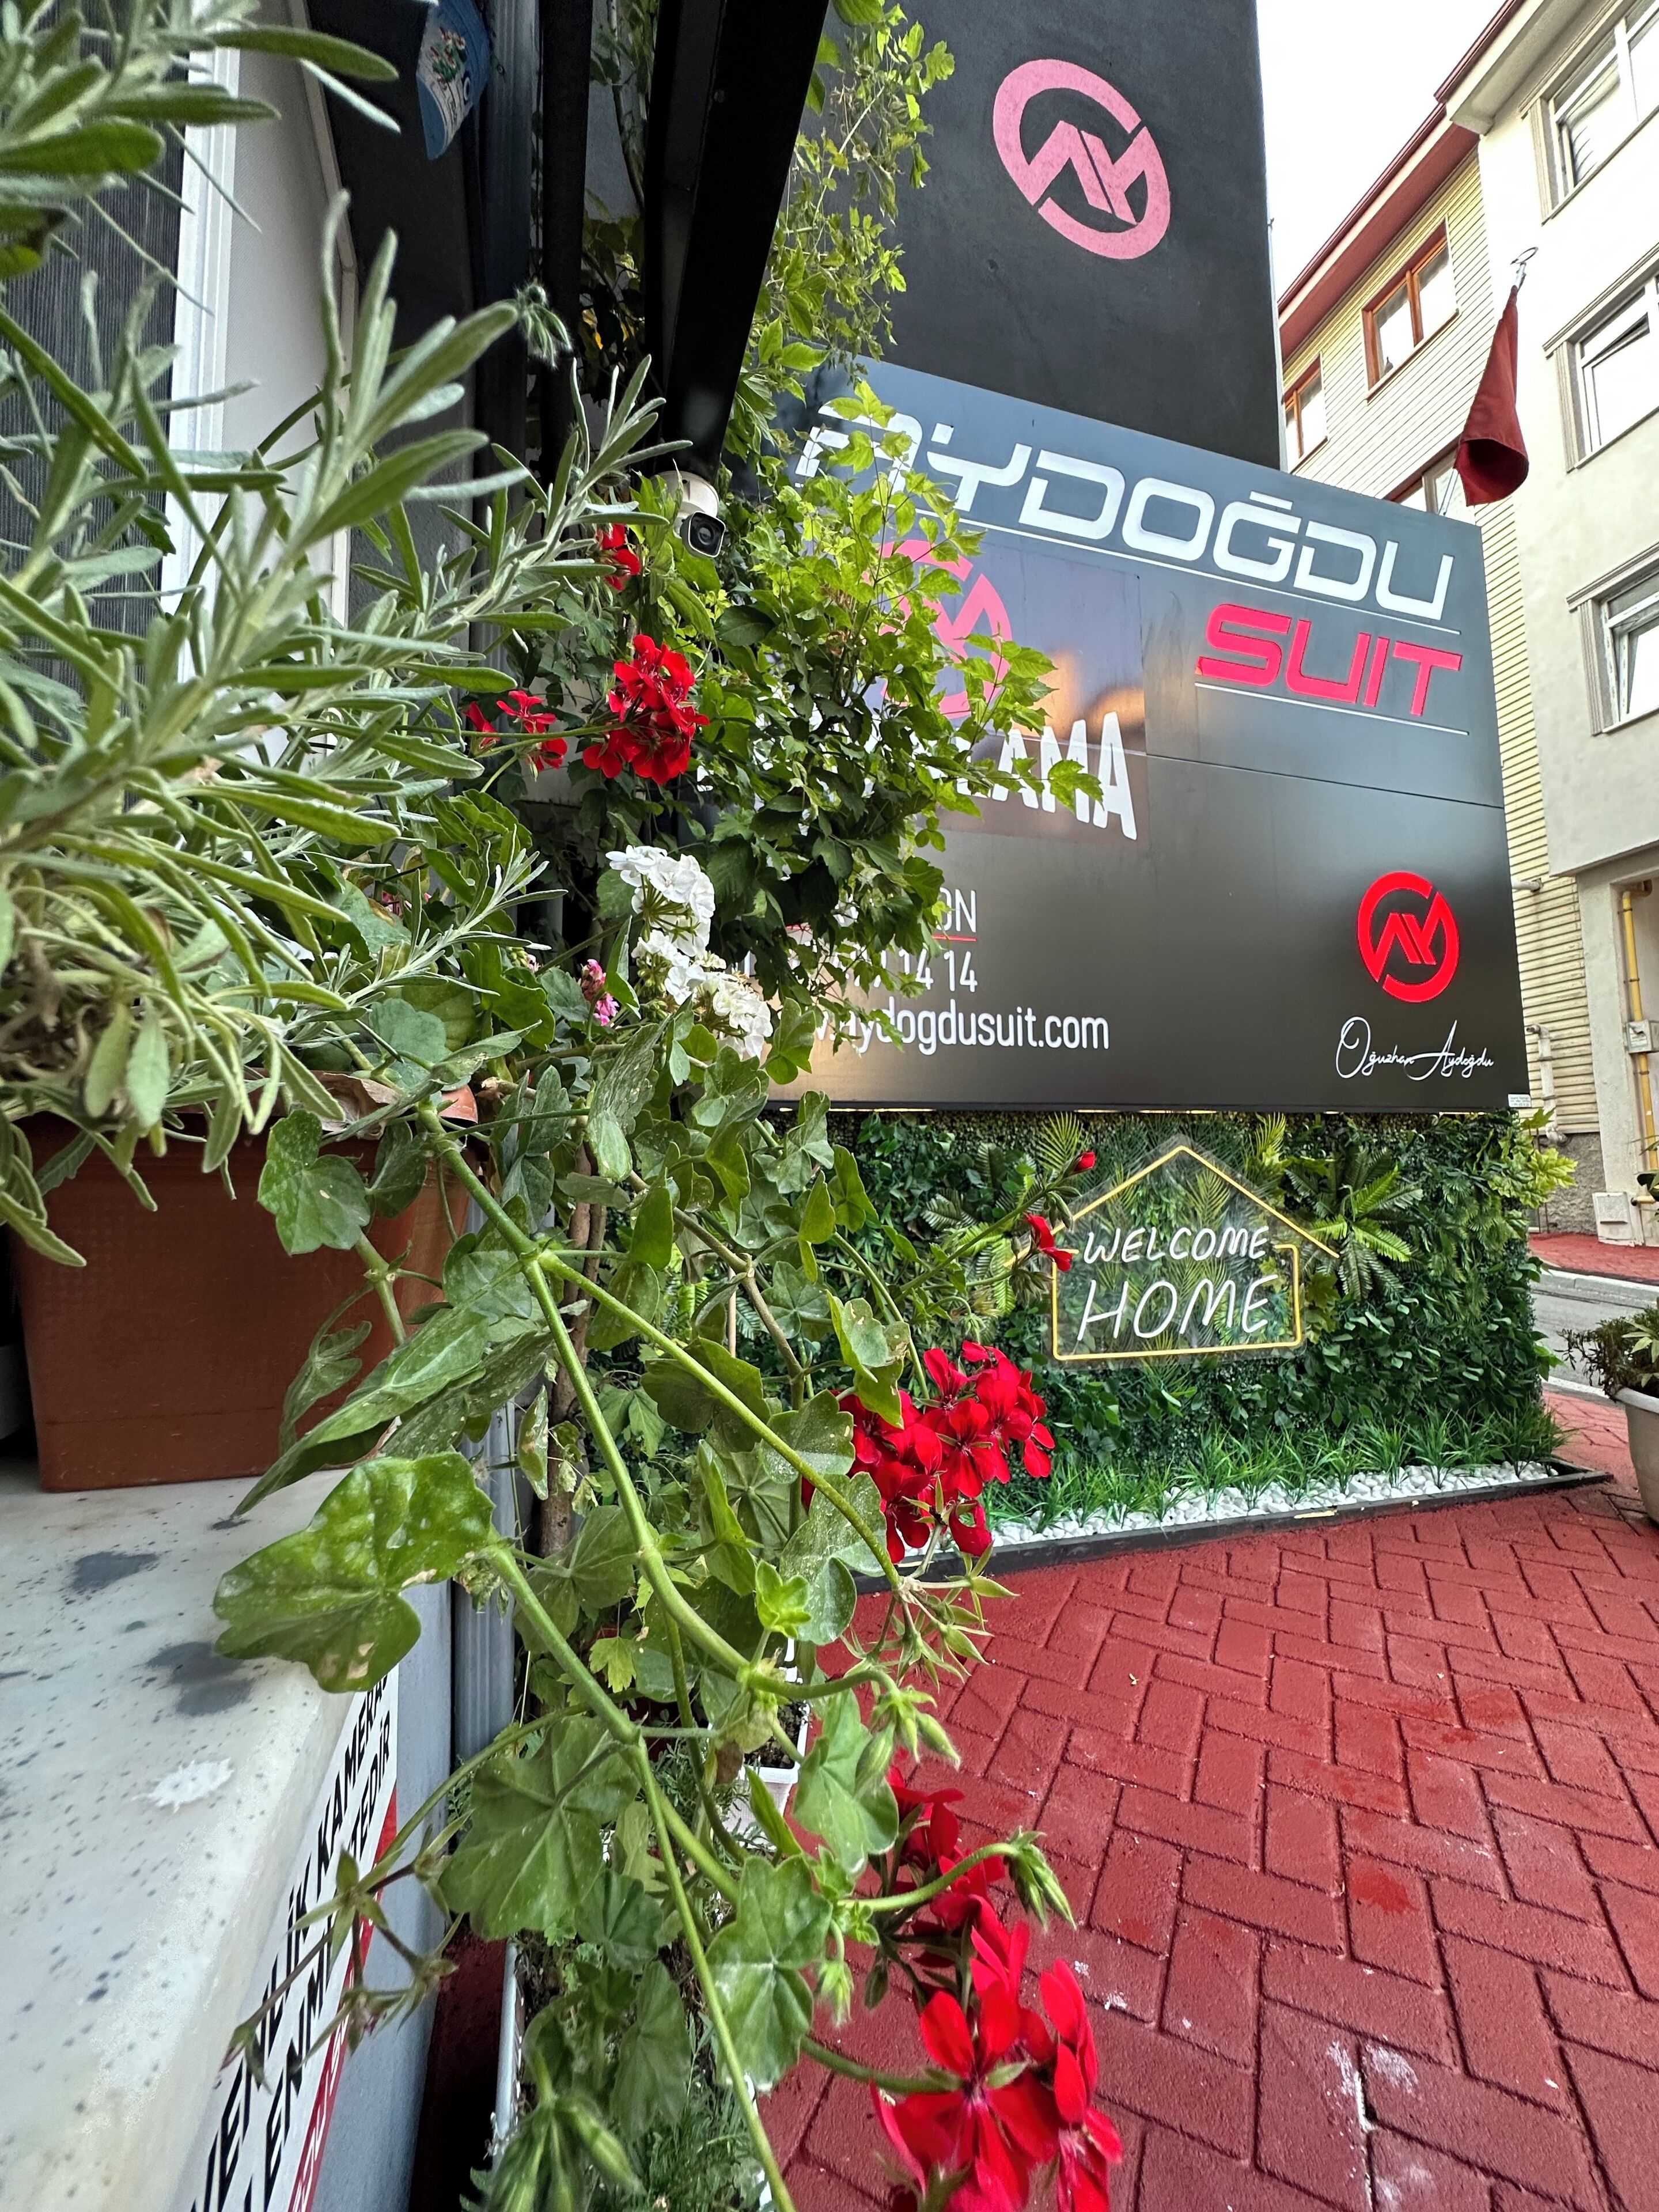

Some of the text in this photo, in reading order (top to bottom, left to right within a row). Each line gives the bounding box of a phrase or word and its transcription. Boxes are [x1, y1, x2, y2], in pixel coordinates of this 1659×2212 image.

[1195, 603, 1463, 717] SUIT
[944, 950, 978, 993] 14
[1084, 1225, 1269, 1264] WELCOME
[1077, 1274, 1278, 1341] HOME
